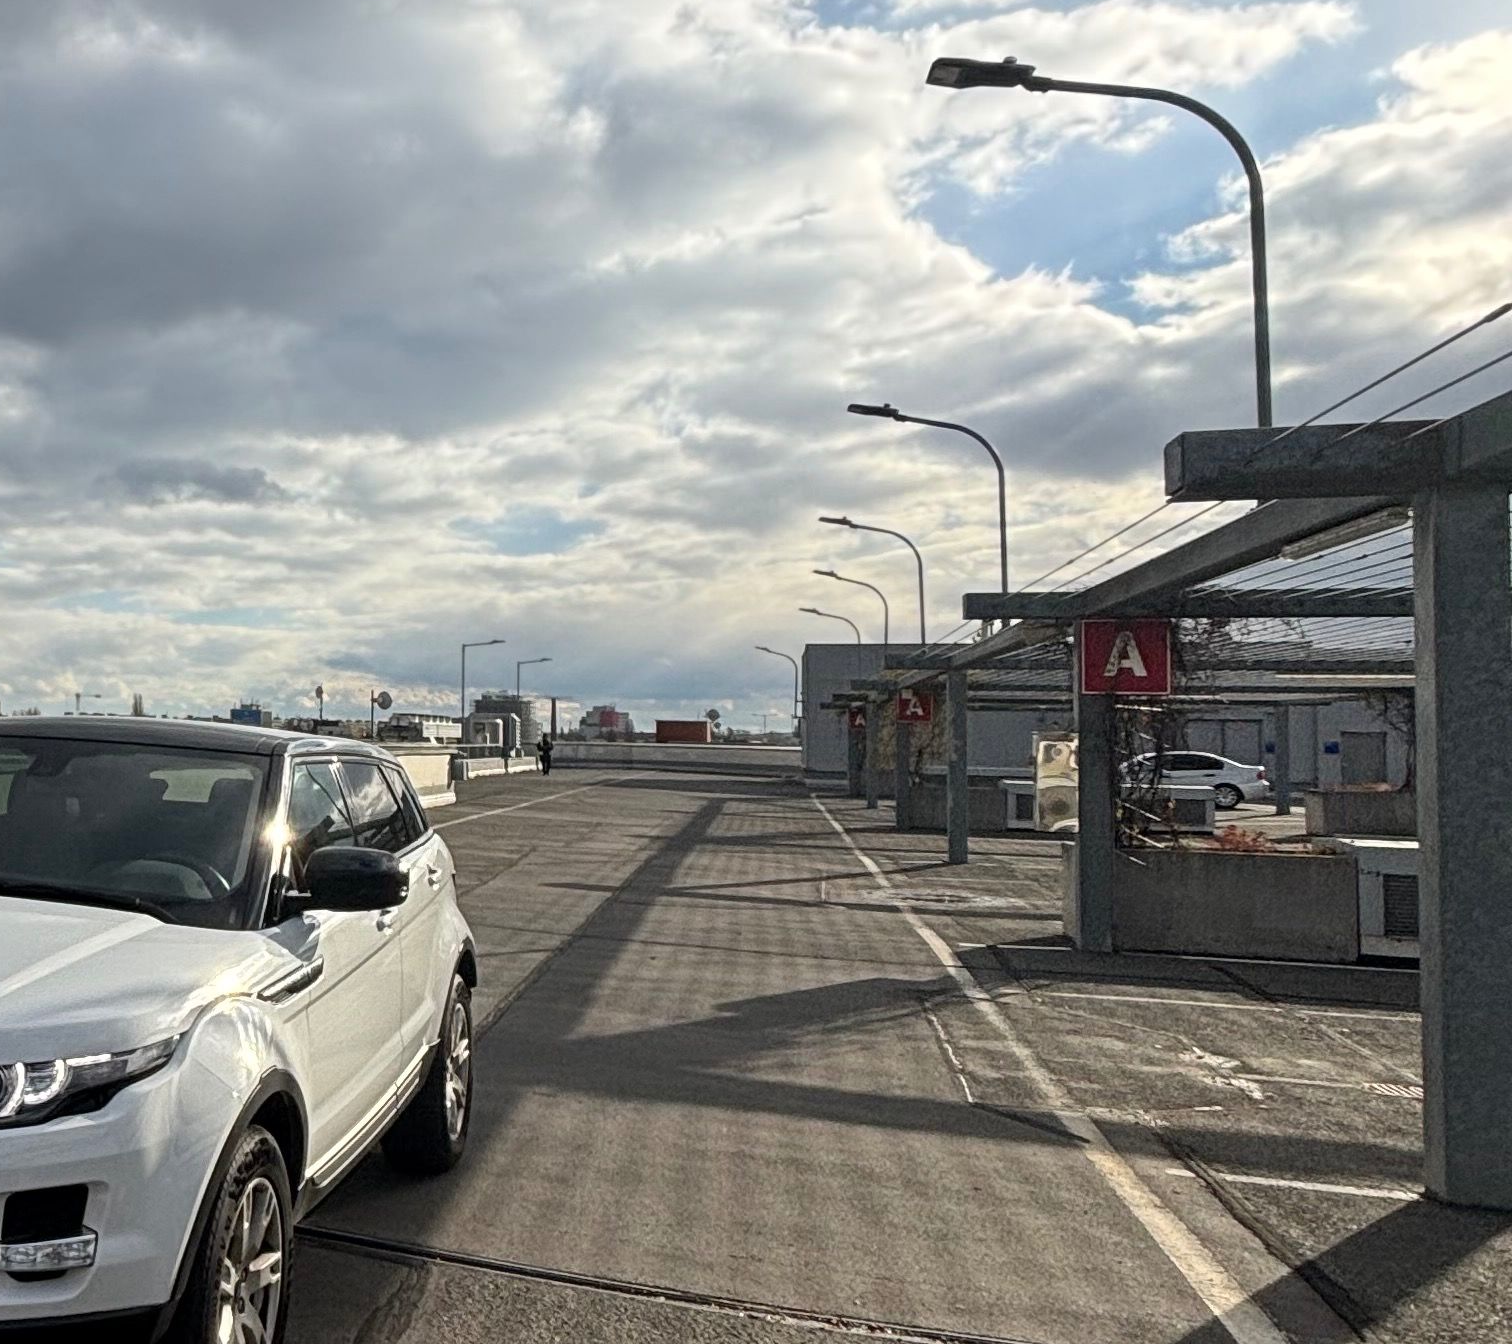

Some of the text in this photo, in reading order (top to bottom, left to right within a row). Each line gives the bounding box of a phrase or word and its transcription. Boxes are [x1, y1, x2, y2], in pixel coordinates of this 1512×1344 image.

[1103, 630, 1148, 677] A
[906, 697, 924, 716] A
[854, 713, 866, 727] A
